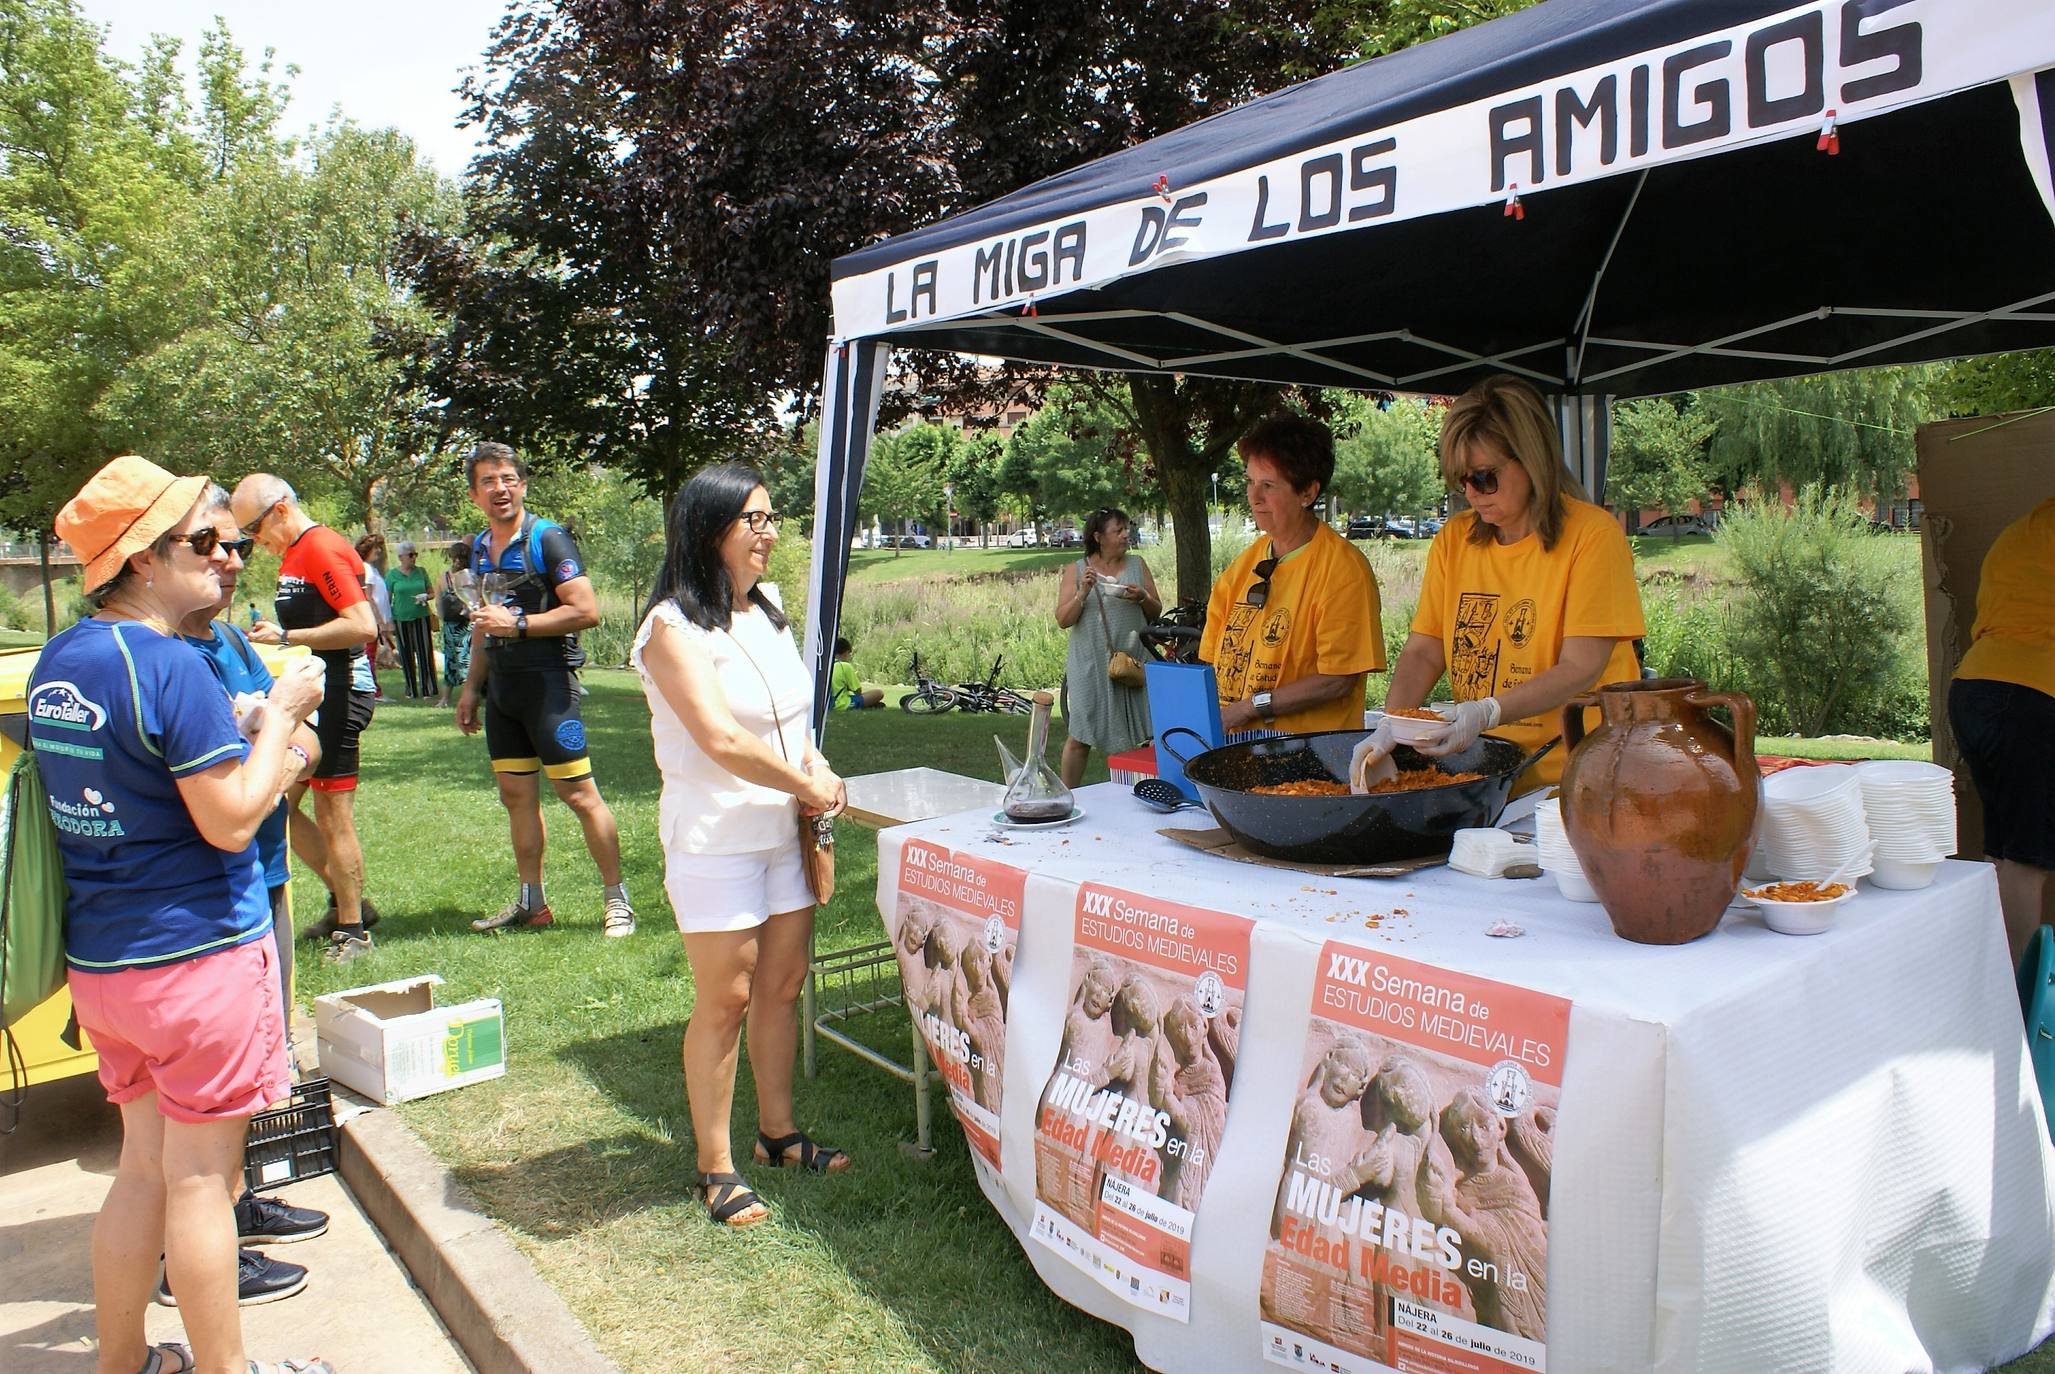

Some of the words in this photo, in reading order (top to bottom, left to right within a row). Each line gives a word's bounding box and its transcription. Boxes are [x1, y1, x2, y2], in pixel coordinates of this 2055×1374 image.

[885, 260, 938, 325] LA
[973, 221, 1087, 305] MIGA
[1128, 191, 1208, 267] DE
[1247, 137, 1397, 242] LOS
[1489, 0, 1923, 192] AMIGOS
[35, 697, 90, 724] EuroTaller
[905, 844, 927, 869] XXX
[928, 851, 975, 885] Semana
[975, 874, 987, 888] de
[904, 868, 951, 897] ESTUDIOS
[952, 883, 1016, 918] MEDIEVALES
[1082, 890, 1112, 919] XXX
[1113, 900, 1179, 937] Semana
[1181, 922, 1195, 940] de
[1080, 919, 1145, 951] ESTUDIOS
[1147, 935, 1238, 976] MEDIEVALES
[1327, 952, 1372, 988] XXX
[1372, 966, 1467, 1015] Semana
[1469, 998, 1490, 1021] de
[1322, 986, 1417, 1030] ESTUDIOS
[1419, 1012, 1552, 1068] MEDIEVALES
[971, 1053, 985, 1072] en
[986, 1055, 996, 1078] la
[1063, 1047, 1091, 1076] Las
[1048, 1072, 1172, 1151] MUJERES
[1166, 1135, 1188, 1157] en
[1189, 1142, 1205, 1166] la
[1040, 1107, 1089, 1151] Edad
[1089, 1132, 1158, 1183] Media
[1294, 1141, 1332, 1176] Las
[1114, 1196, 1122, 1206] 22
[1136, 1207, 1145, 1217] de
[1144, 1210, 1159, 1223] julio
[1158, 1217, 1168, 1226] de
[1167, 1221, 1185, 1235] 2019
[1285, 1170, 1464, 1271] MUJERES
[1466, 1256, 1498, 1285] en
[1504, 1263, 1529, 1293] la
[1279, 1217, 1351, 1272] Edad
[1359, 1248, 1464, 1310] Media
[1398, 1301, 1438, 1324] NÁJERA
[1398, 1314, 1414, 1329] Del
[1416, 1321, 1428, 1332] 22
[1430, 1326, 1439, 1337] al
[1441, 1330, 1453, 1341] 26
[1455, 1334, 1468, 1346] de
[1470, 1338, 1492, 1353] julio
[1493, 1345, 1507, 1357] de
[1509, 1350, 1536, 1366] 2019
